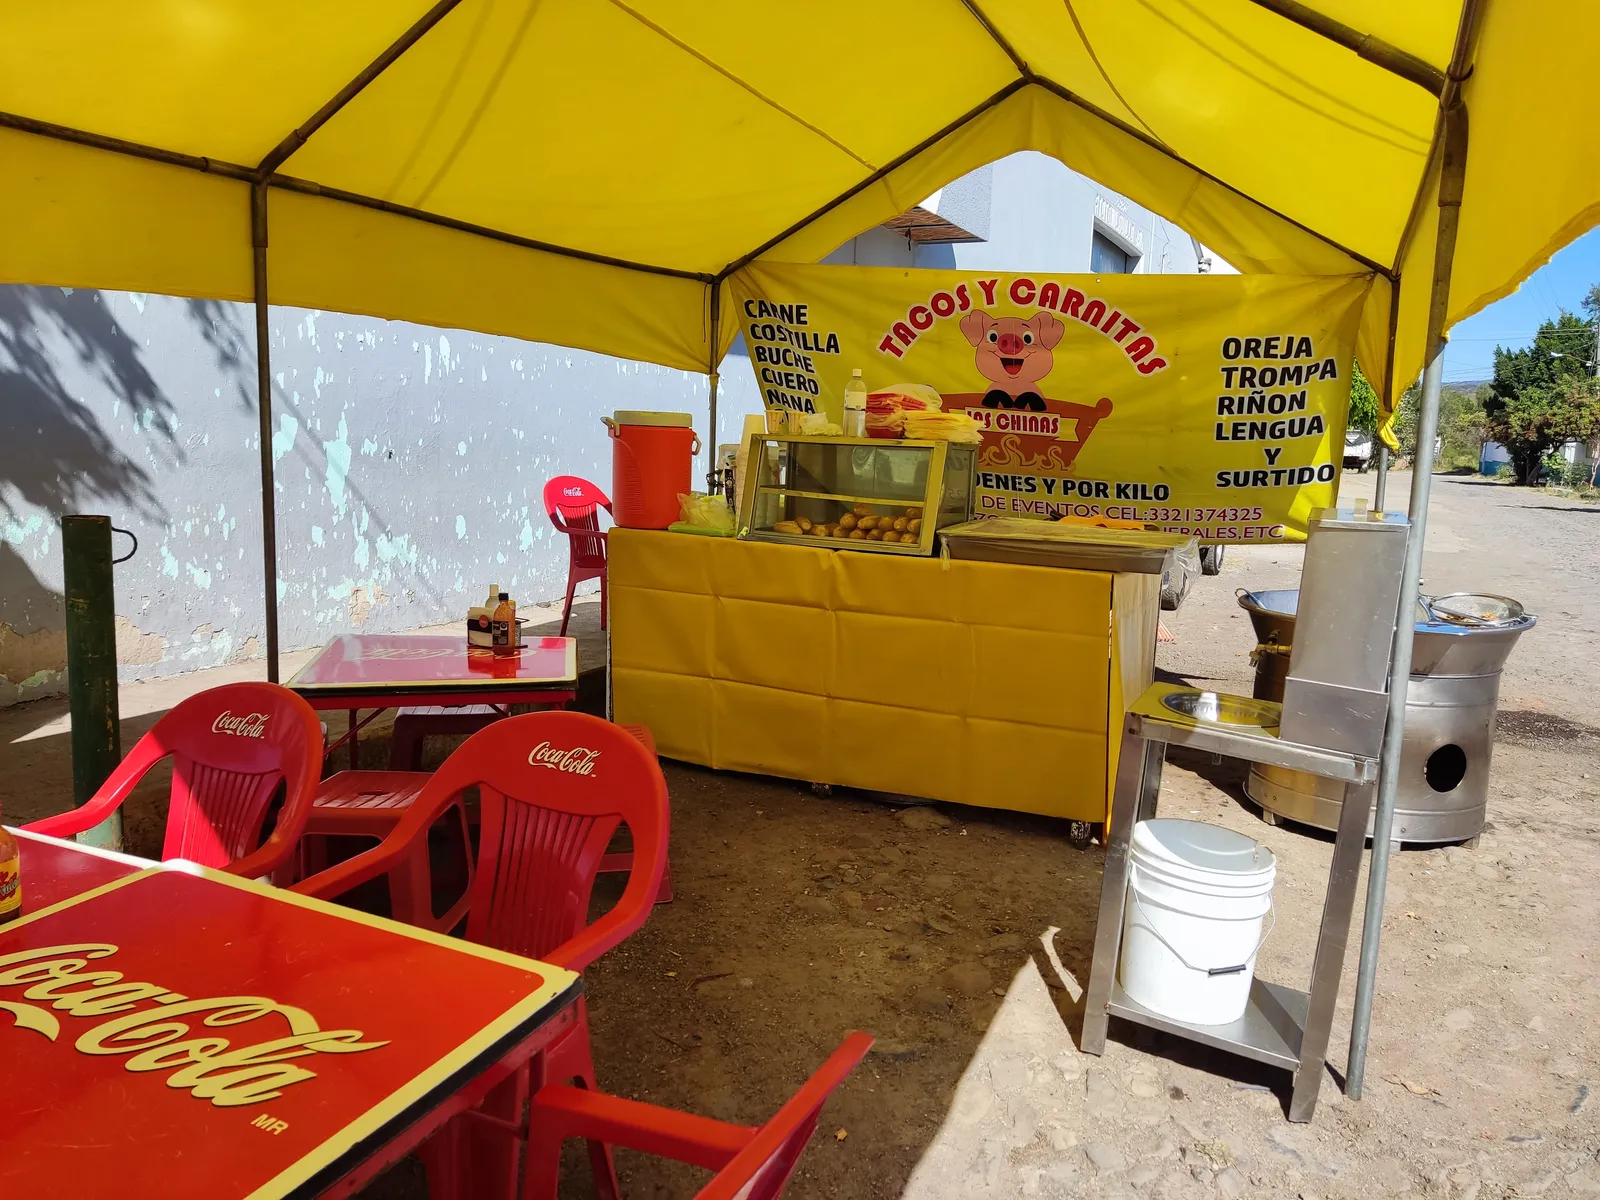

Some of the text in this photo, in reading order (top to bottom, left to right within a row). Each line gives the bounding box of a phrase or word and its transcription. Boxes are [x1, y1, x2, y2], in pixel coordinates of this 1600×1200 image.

[743, 299, 808, 325] CARNE
[750, 323, 840, 354] COSTILLA
[878, 278, 1168, 375] TACOS Y CARNITAS
[754, 345, 815, 374] BUCHE
[1222, 336, 1313, 360] OREJA
[761, 367, 819, 396] CUERO
[1221, 358, 1337, 389] TROMPA
[766, 388, 816, 414] NANA
[1217, 390, 1307, 416] RIÑON
[996, 413, 1059, 434] CHINAS
[1215, 415, 1324, 441] LENGUA
[1263, 447, 1282, 466] Y
[977, 471, 1170, 501] ENES Y POR KILO
[1216, 464, 1336, 488] SURTIDO
[981, 495, 1007, 511] DE
[1012, 498, 1100, 518] EVENTOS
[250, 1113, 289, 1136] MR
